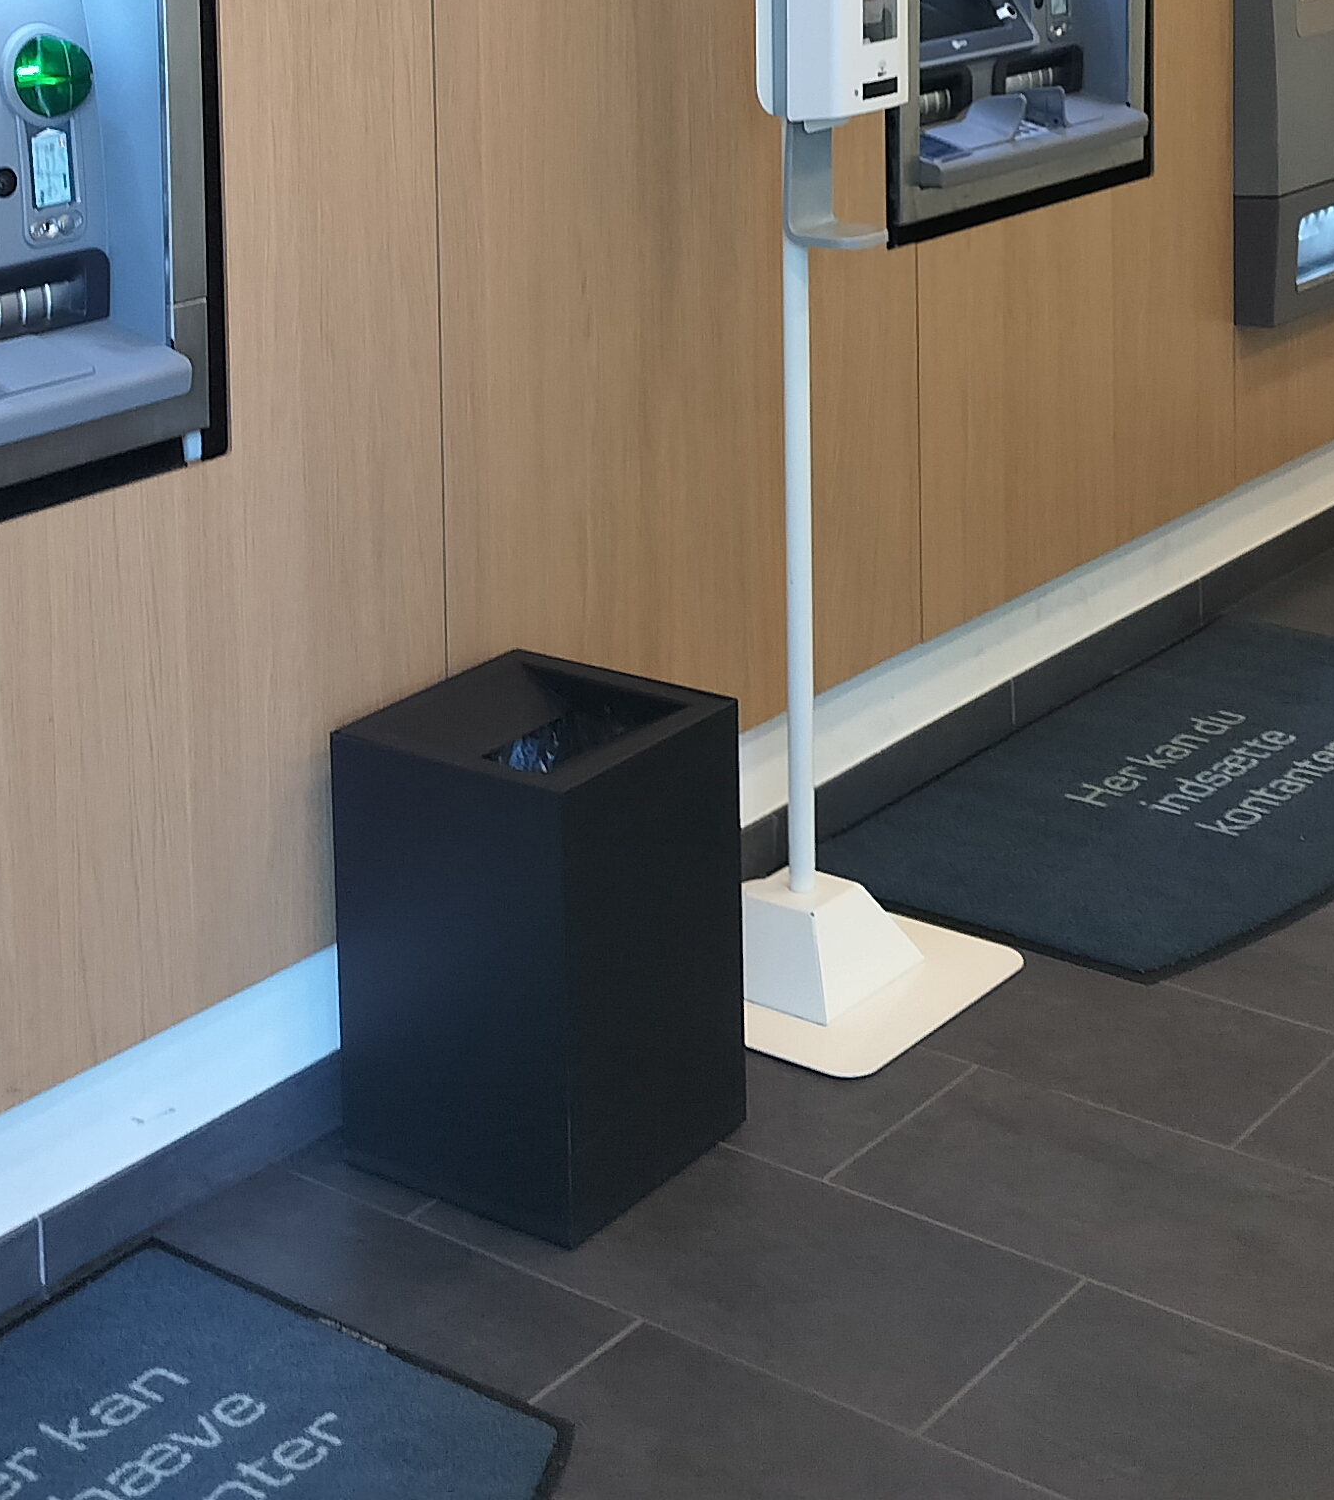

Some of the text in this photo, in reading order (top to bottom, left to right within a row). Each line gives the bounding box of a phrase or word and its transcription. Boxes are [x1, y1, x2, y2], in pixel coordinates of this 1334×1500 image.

[1065, 709, 1248, 809] Her kan du
[1139, 729, 1297, 815] indsætte
[39, 1366, 194, 1452] kan
